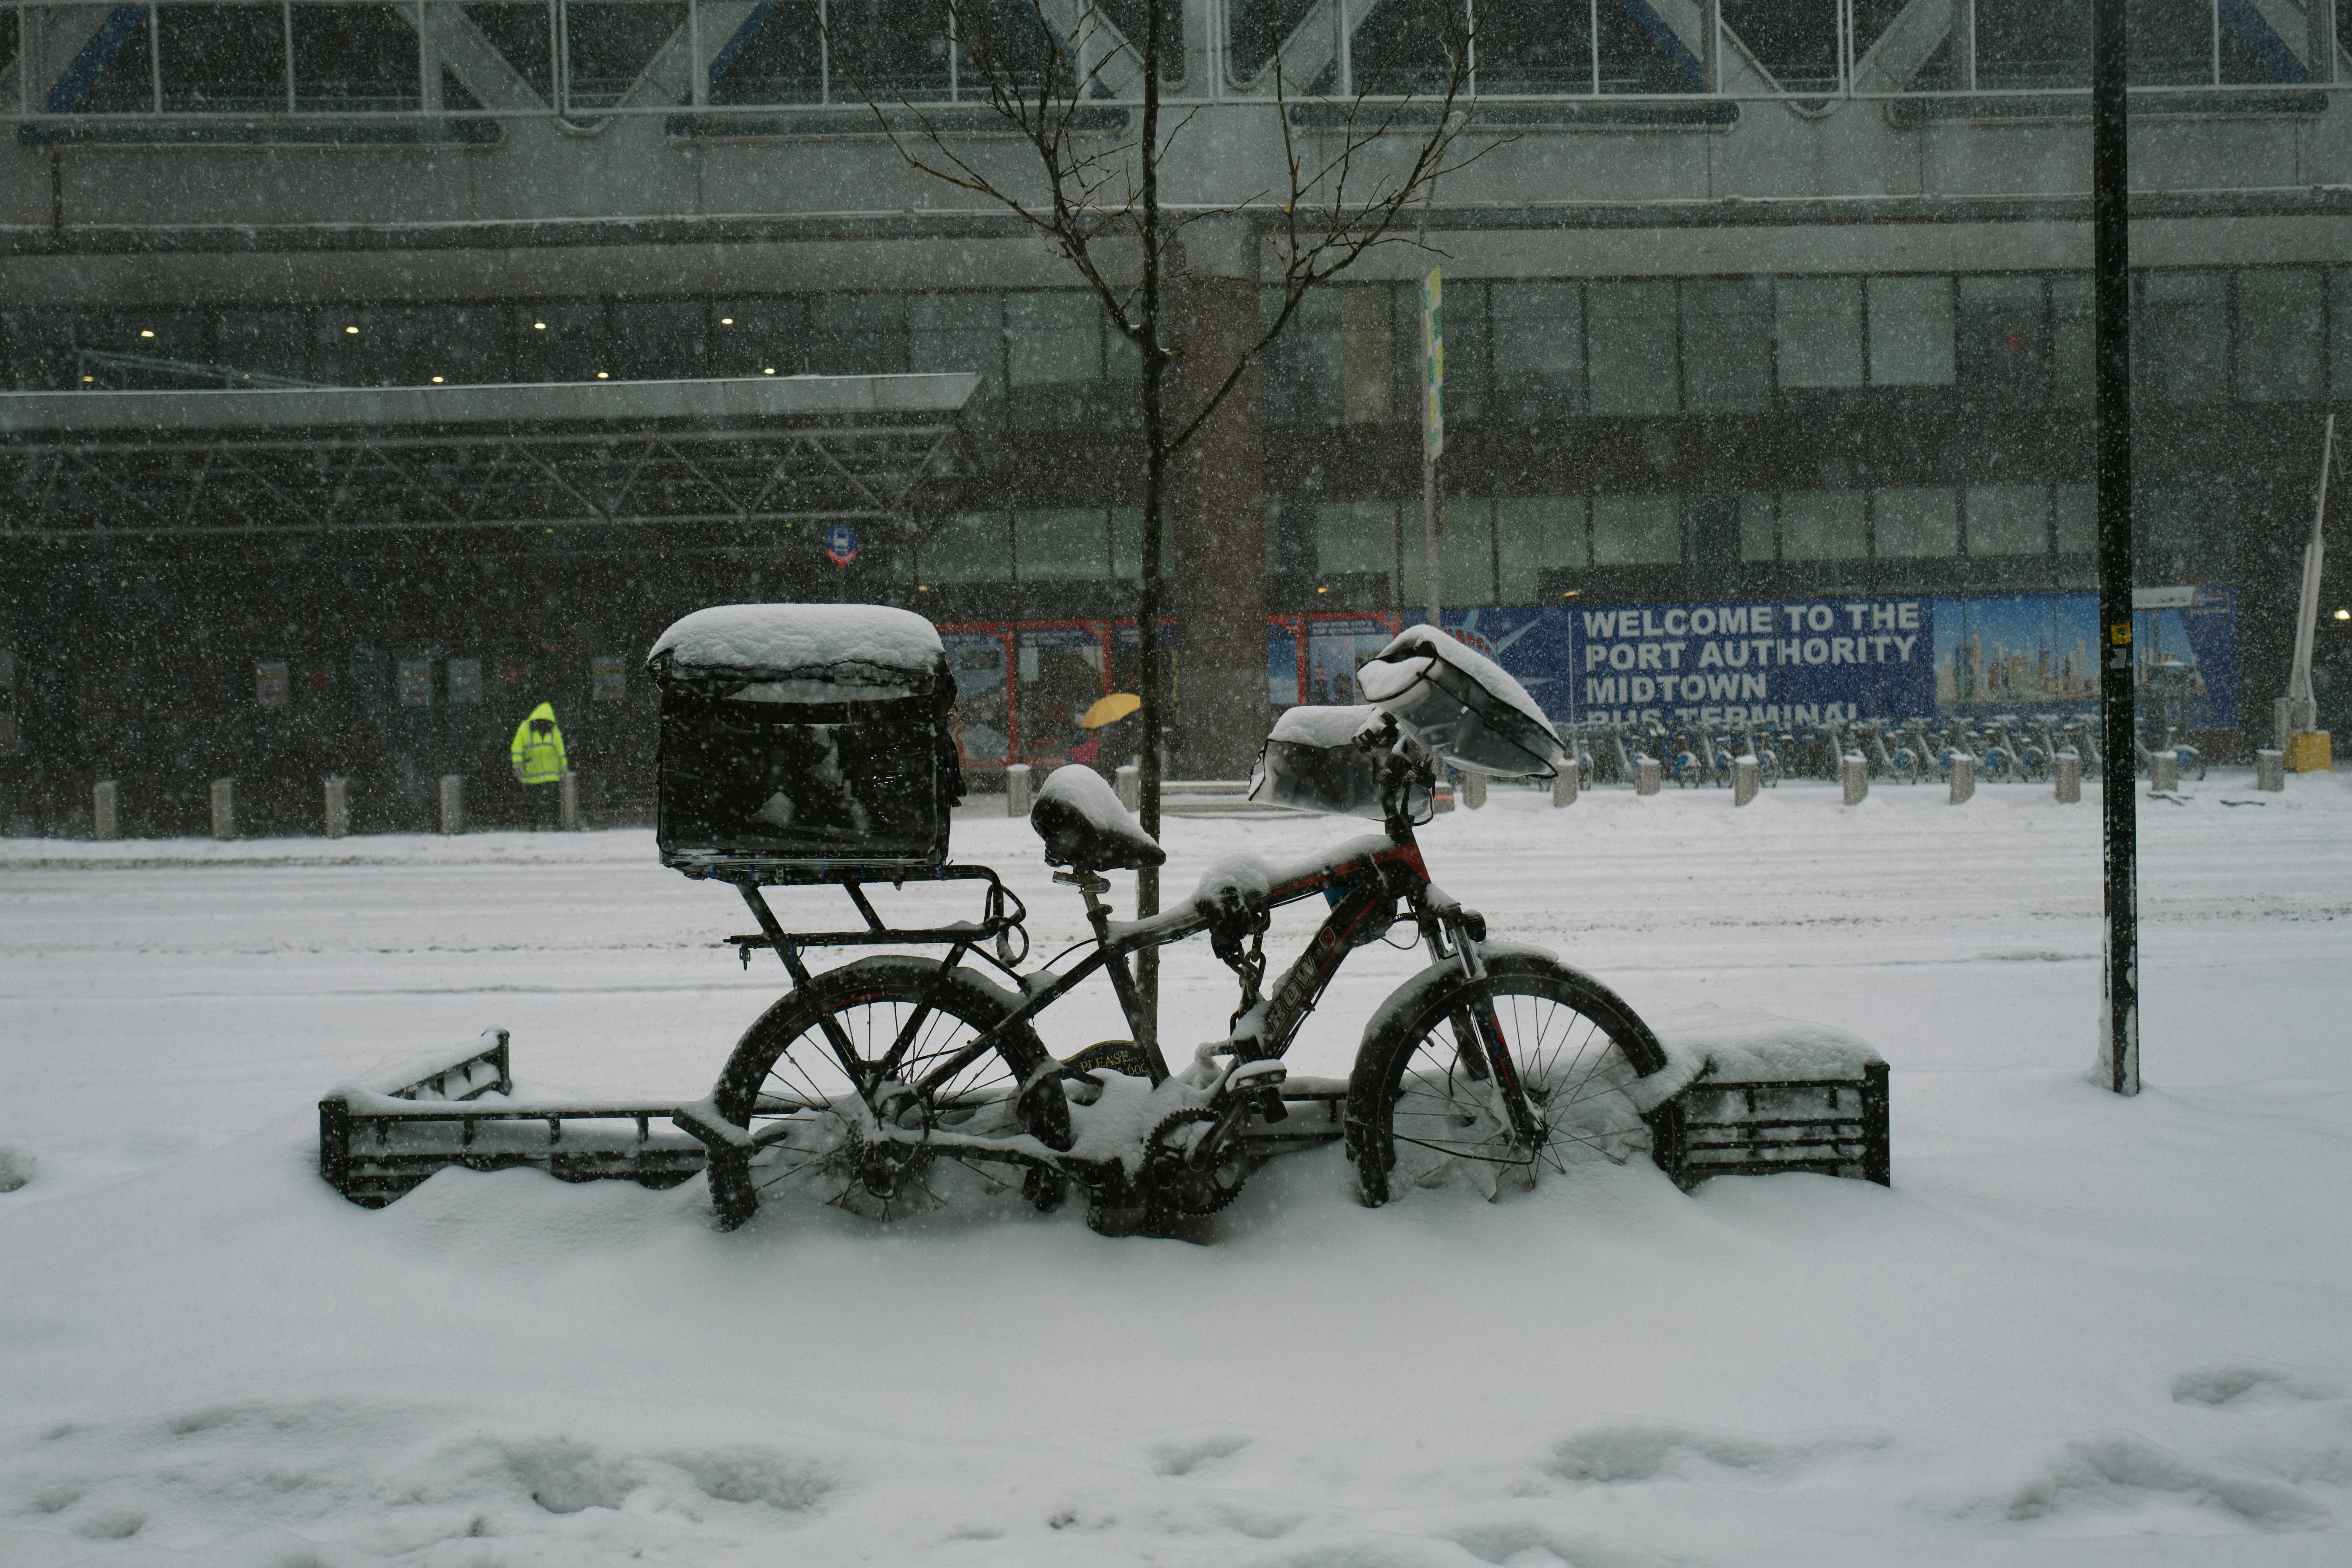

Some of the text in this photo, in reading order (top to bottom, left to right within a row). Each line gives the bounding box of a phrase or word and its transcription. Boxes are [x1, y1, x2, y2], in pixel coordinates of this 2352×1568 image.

[1582, 602, 1920, 638] WELCOME TO THE
[1585, 635, 1918, 671] PORT AUTHORITY
[1586, 672, 1766, 704] MIDTOWN
